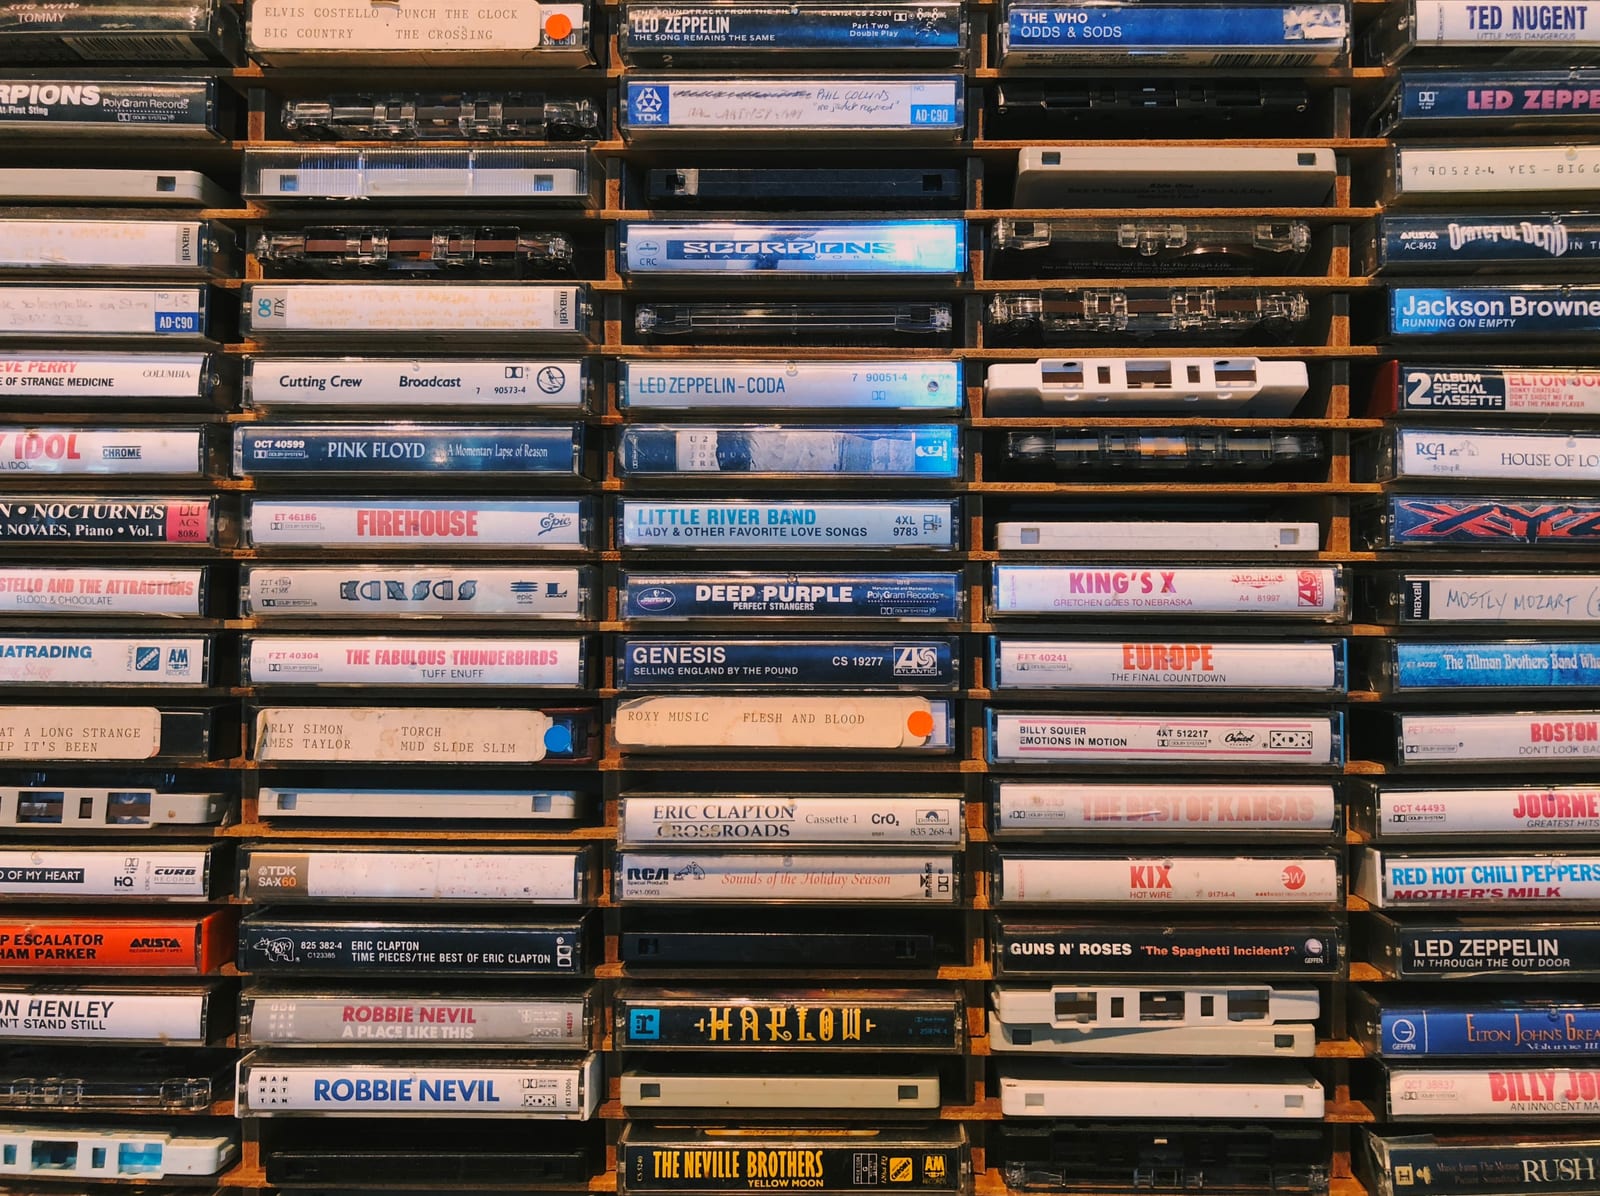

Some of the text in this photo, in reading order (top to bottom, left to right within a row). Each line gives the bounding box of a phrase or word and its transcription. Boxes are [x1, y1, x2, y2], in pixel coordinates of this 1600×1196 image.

[18, 13, 66, 23] TOMMY
[266, 8, 518, 20] ELVIS COSTELLO PUNCH THE CLOCK
[1021, 13, 1088, 23] THE WHO
[1466, 6, 1502, 30] TED
[1512, 6, 1588, 30] NUGENT
[634, 16, 730, 34] LED ZEPPELIN
[265, 28, 493, 41] BIG COUNTRY THE CROSSING
[1021, 26, 1122, 38] ODDS & SODS
[635, 113, 662, 122] TDK
[182, 228, 191, 261] maxell
[1404, 241, 1437, 251] AC-8452
[560, 291, 568, 325] maxell
[1402, 296, 1600, 316] Jackson Browne
[159, 316, 193, 329] AD-C90
[1402, 318, 1517, 328] RUNNING ON EMPTY
[142, 369, 192, 379] COLUMBIA
[6, 377, 115, 388] OF STRANGE MEDICINE
[279, 374, 462, 392] Cutting Crew Broadcast
[1433, 383, 1488, 395] SPECIAL
[1433, 395, 1502, 407] CASSETTE
[102, 448, 142, 458] CHROME
[328, 442, 426, 459] PINK FLOYD
[33, 503, 165, 520] NOCTURNES
[638, 509, 816, 526] LITTLE RIVER BAND
[356, 510, 479, 537] FIREHOUSE
[638, 527, 868, 538] LADY & OTHER FAVORITE LOVE SONGS
[893, 528, 918, 537] 9783
[696, 585, 853, 603] DEEP PURPLE
[733, 602, 814, 612] PERFECT STRANGERS
[346, 649, 558, 667] THE FABULOUS THUNDERBIRDS
[632, 647, 726, 664] GENESIS
[832, 656, 884, 667] CS 19277
[1122, 643, 1214, 671] EUROPE
[421, 669, 485, 679] TUFF ENUFF
[634, 667, 798, 676] SELLING ENGLAND BY THE POUND
[1111, 673, 1227, 683] THE FINAL COUNTDOWN
[628, 711, 865, 725] ROXY MUSIC FLESH AND BLOOD
[41, 727, 141, 738] LONG STRANGE
[303, 724, 442, 737] SIMON TORCH
[1019, 726, 1086, 736] BILLY SQUIER
[1176, 730, 1209, 739] 512217
[1530, 722, 1598, 742] BOSTON
[1020, 736, 1127, 747] EMOTIONS IN MOTION
[1223, 732, 1255, 745] Capitol
[24, 742, 98, 753] IT'S BEEN
[303, 738, 516, 754] TAYLOR MUD SLIDE SLIM
[653, 804, 795, 820] ERIC CLAPTON
[8, 871, 81, 881] OF MY HEART
[1130, 866, 1172, 889] KIX
[1391, 863, 1600, 885] RED HOT CHILI PEPPERS
[1393, 887, 1560, 899] MOTHER'S MILK
[14, 934, 103, 946] ESCALATOR
[130, 938, 181, 948] ARISTA
[351, 941, 419, 951] ERIC CLAPTON
[35, 948, 96, 960] PARKER
[1010, 943, 1295, 958] GUNS N' ROSES "The Spaghetti Incident?"
[1414, 939, 1558, 957] LED ZEPPELIN
[352, 952, 551, 965] TIME PIECES/THE BEST OF ERIC CLAPTON
[1413, 958, 1570, 968] IN THROUGH THE OUT DOOR
[28, 1000, 114, 1018] HENLEY
[342, 1006, 476, 1023] ROBBIE NEVIL
[24, 1018, 106, 1031] STAND STILL
[342, 1025, 474, 1039] A PLACE LIKE THIS
[313, 1079, 500, 1102] ROBBIE NEVIL
[653, 1150, 824, 1178] THE NEVILLE BROTHERS
[1521, 1157, 1596, 1183] RUSH
[747, 1179, 824, 1188] YELLOW MOON
